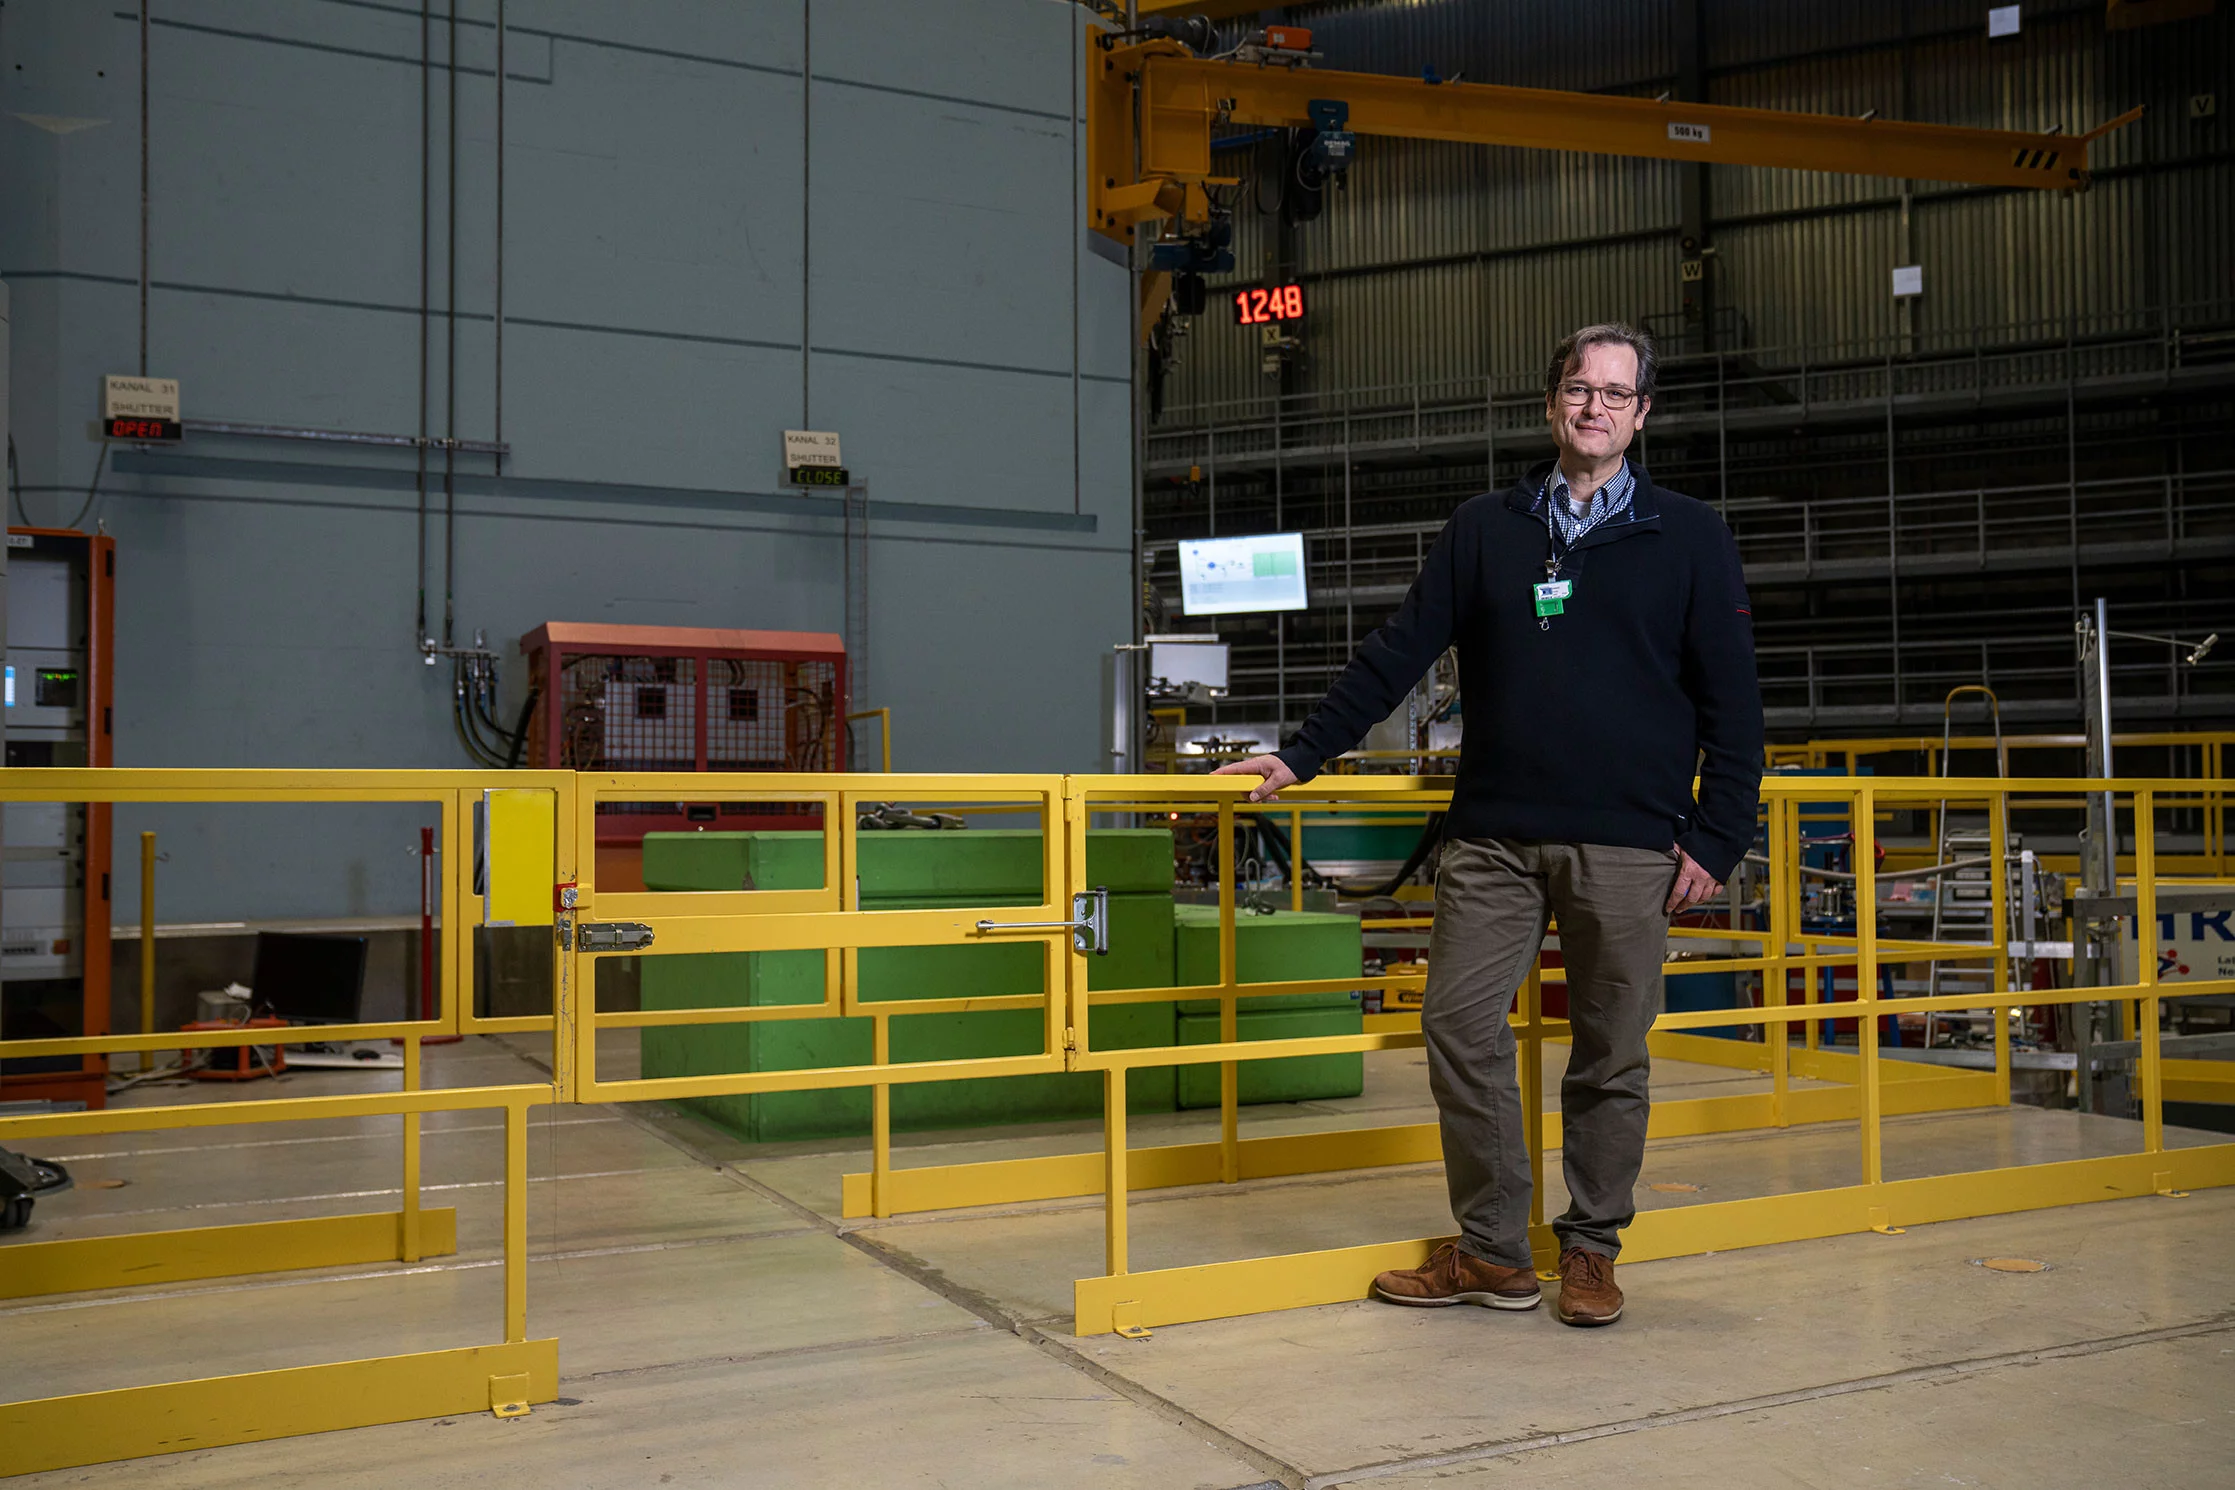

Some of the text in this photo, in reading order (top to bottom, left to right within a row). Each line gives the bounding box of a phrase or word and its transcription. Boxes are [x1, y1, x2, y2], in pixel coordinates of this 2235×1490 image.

[2196, 97, 2209, 113] V
[1674, 126, 1703, 139] 500 kg
[1684, 263, 1700, 277] W
[1236, 284, 1303, 324] 1248
[1266, 328, 1277, 341] X
[109, 382, 176, 395] KANAL 31
[111, 402, 175, 415] SHUTTER
[787, 435, 837, 446] KANAL 32
[790, 454, 838, 465] SHUTTER
[796, 470, 842, 485] CLOSE
